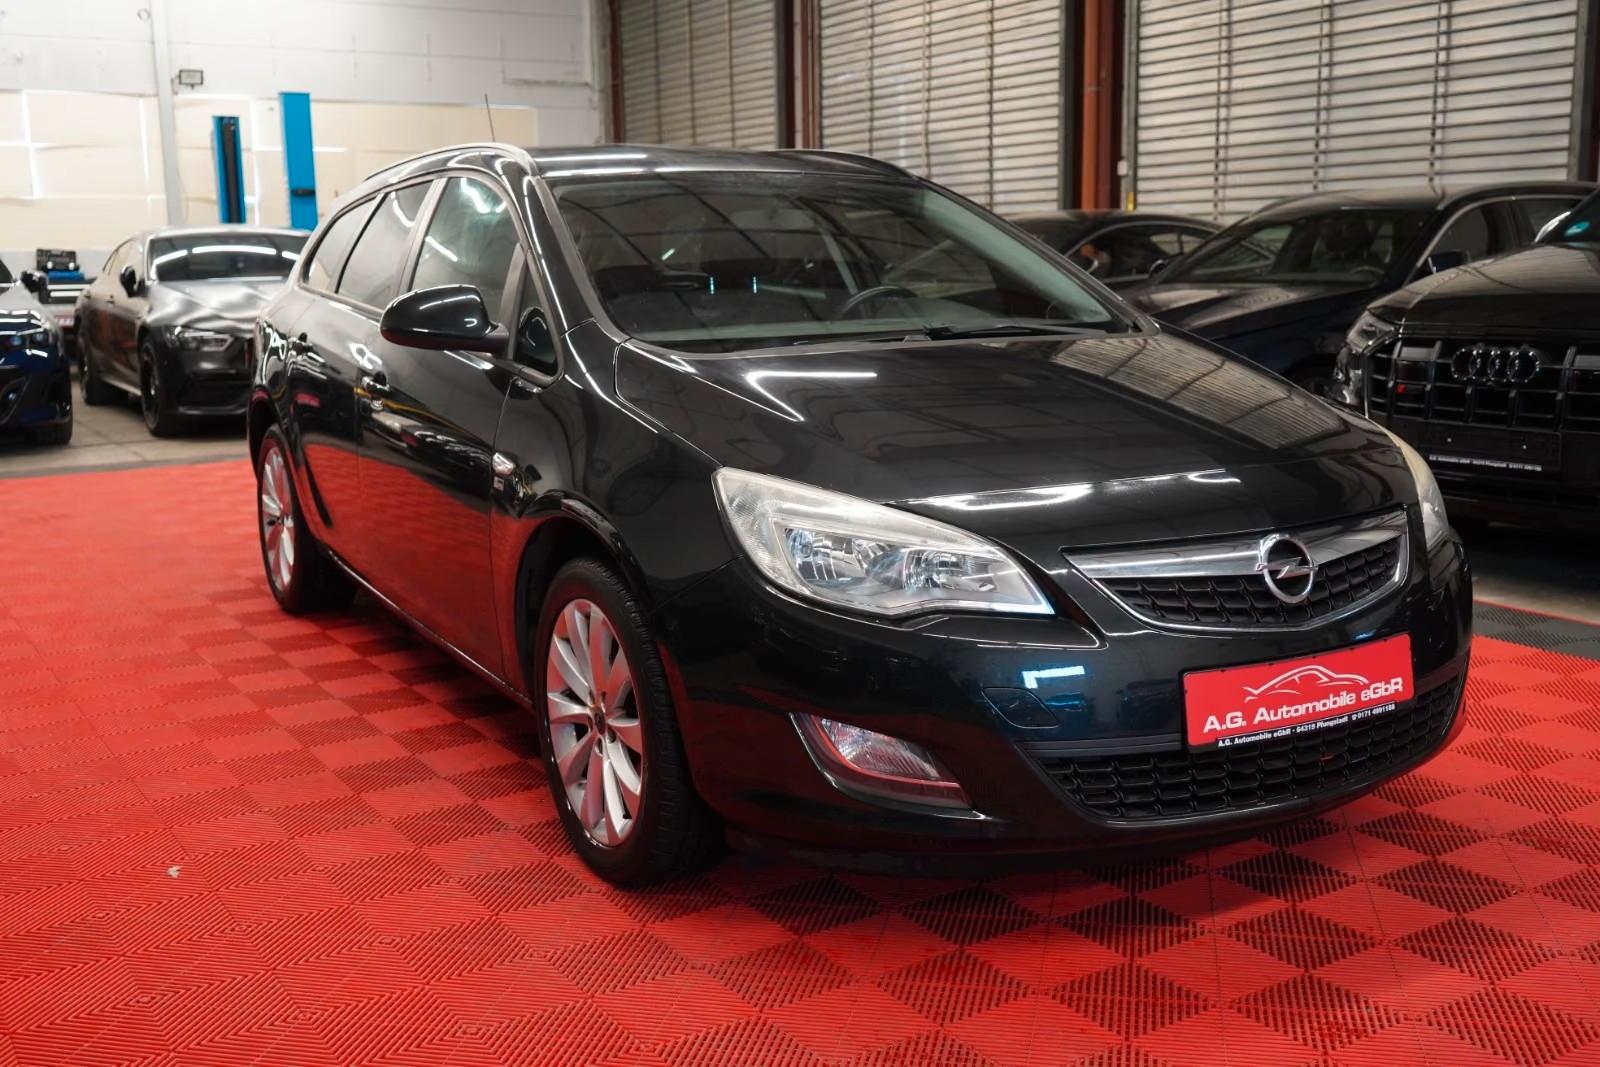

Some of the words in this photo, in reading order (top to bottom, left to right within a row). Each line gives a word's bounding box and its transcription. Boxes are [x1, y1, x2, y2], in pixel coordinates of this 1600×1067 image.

[1203, 711, 1247, 734] A.G.
[1253, 690, 1356, 724] Automobile
[1360, 677, 1404, 702] eGbR
[1218, 739, 1233, 747] A.G.
[1234, 731, 1272, 745] Automobile
